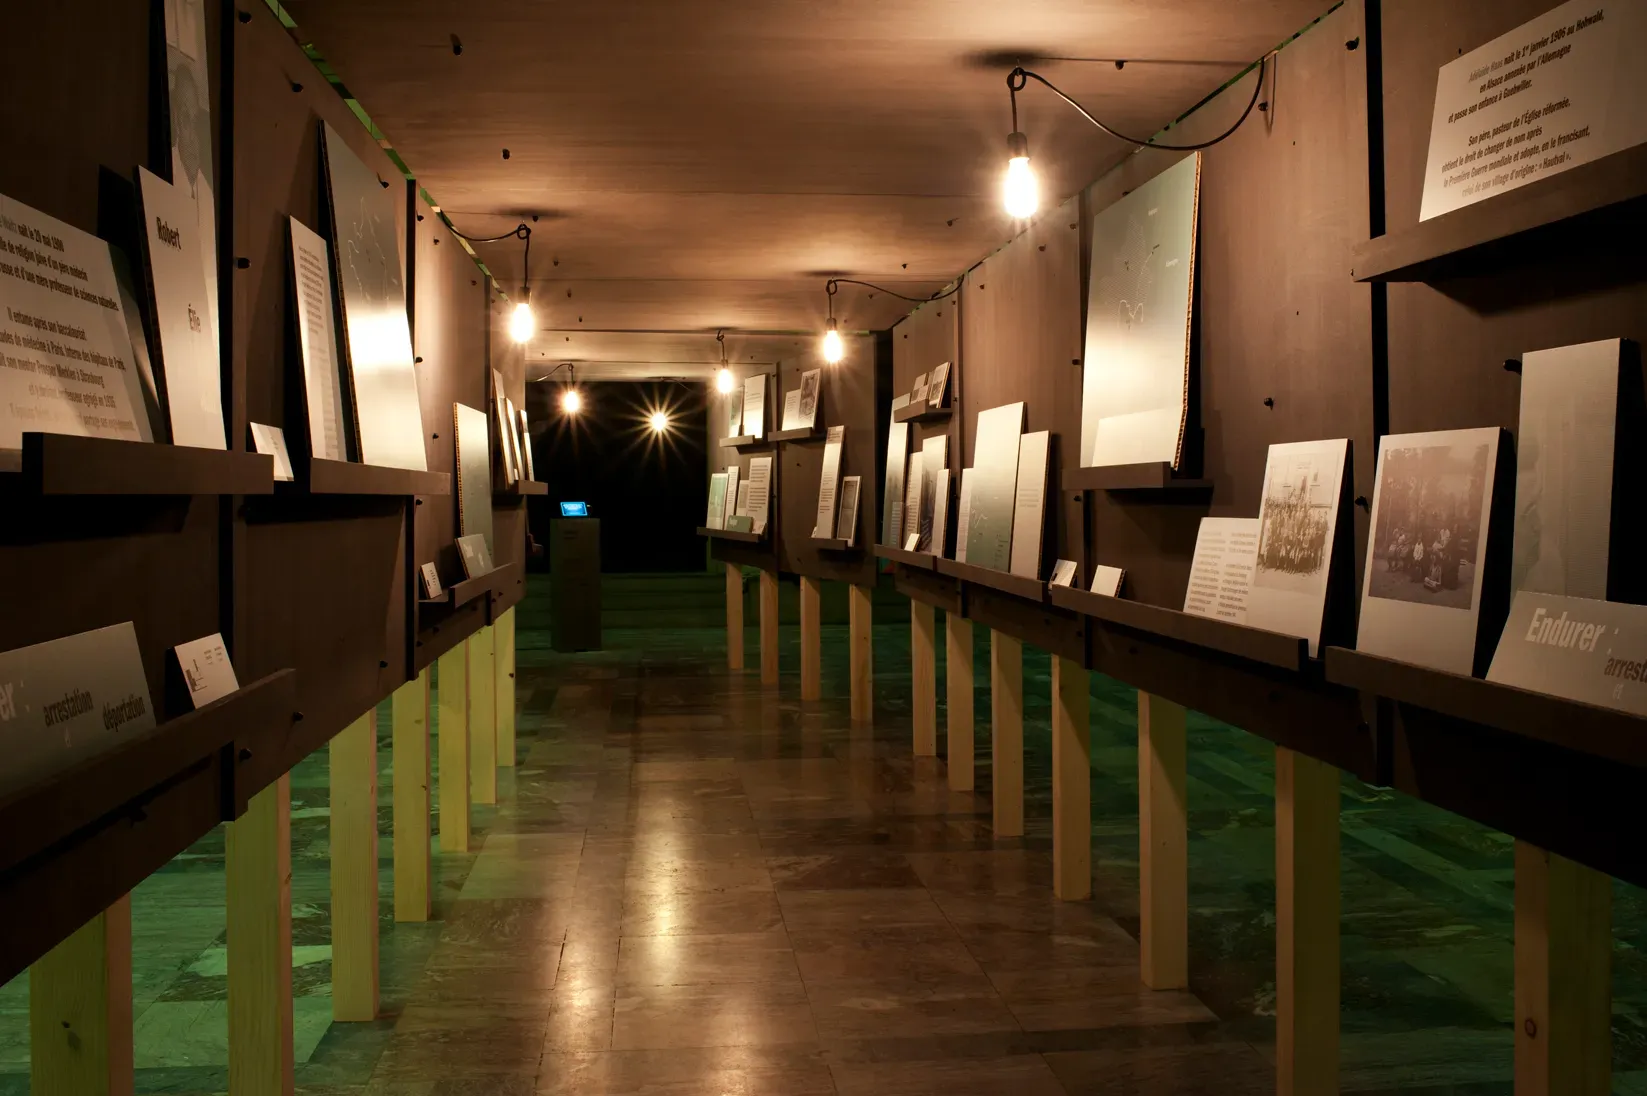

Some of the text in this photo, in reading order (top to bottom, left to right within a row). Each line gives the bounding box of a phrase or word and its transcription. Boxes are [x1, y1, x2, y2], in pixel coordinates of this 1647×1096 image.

[1504, 53, 1514, 67] naît
[1515, 51, 1521, 61] le
[1529, 37, 1549, 56] janvier
[1550, 27, 1566, 44] 1906
[1567, 25, 1574, 35] au
[1576, 10, 1604, 32] Hohwald,
[1480, 83, 1486, 93] en
[1487, 75, 1503, 90] Alsace
[1504, 65, 1525, 81] annexée
[1526, 60, 1536, 74] par
[1454, 108, 1468, 123] passe
[1469, 104, 1477, 114] son
[1478, 96, 1498, 110] enfance
[1459, 156, 1464, 165] le
[1465, 150, 1476, 163] droit
[1477, 147, 1483, 158] de
[1484, 139, 1505, 158] changer
[1506, 136, 1513, 147] de
[1514, 132, 1525, 143] nom
[1527, 126, 1542, 141] après
[1469, 135, 1478, 146] Son
[1479, 129, 1491, 144] père,
[1492, 121, 1512, 138] pasteur
[1513, 116, 1520, 128] de
[1449, 169, 1469, 185] Première
[1471, 165, 1488, 178] Guerre
[1489, 155, 1512, 171] mondiale
[1513, 152, 1519, 161] et
[1520, 145, 1541, 160] adopte,
[1542, 142, 1549, 151] en
[1550, 138, 1556, 148] le
[1557, 125, 1590, 147] francisant,
[1474, 182, 1481, 193] de
[1482, 179, 1491, 190] son
[1492, 171, 1509, 185] village
[1543, 152, 1566, 168] Hautval
[157, 217, 181, 250] Robert
[15, 244, 35, 262] religion
[33, 315, 48, 330] après
[48, 321, 57, 332] son
[81, 348, 90, 362] des
[1525, 607, 1604, 652] Endurer
[43, 688, 94, 728] arrestation
[103, 695, 146, 732] déportation
